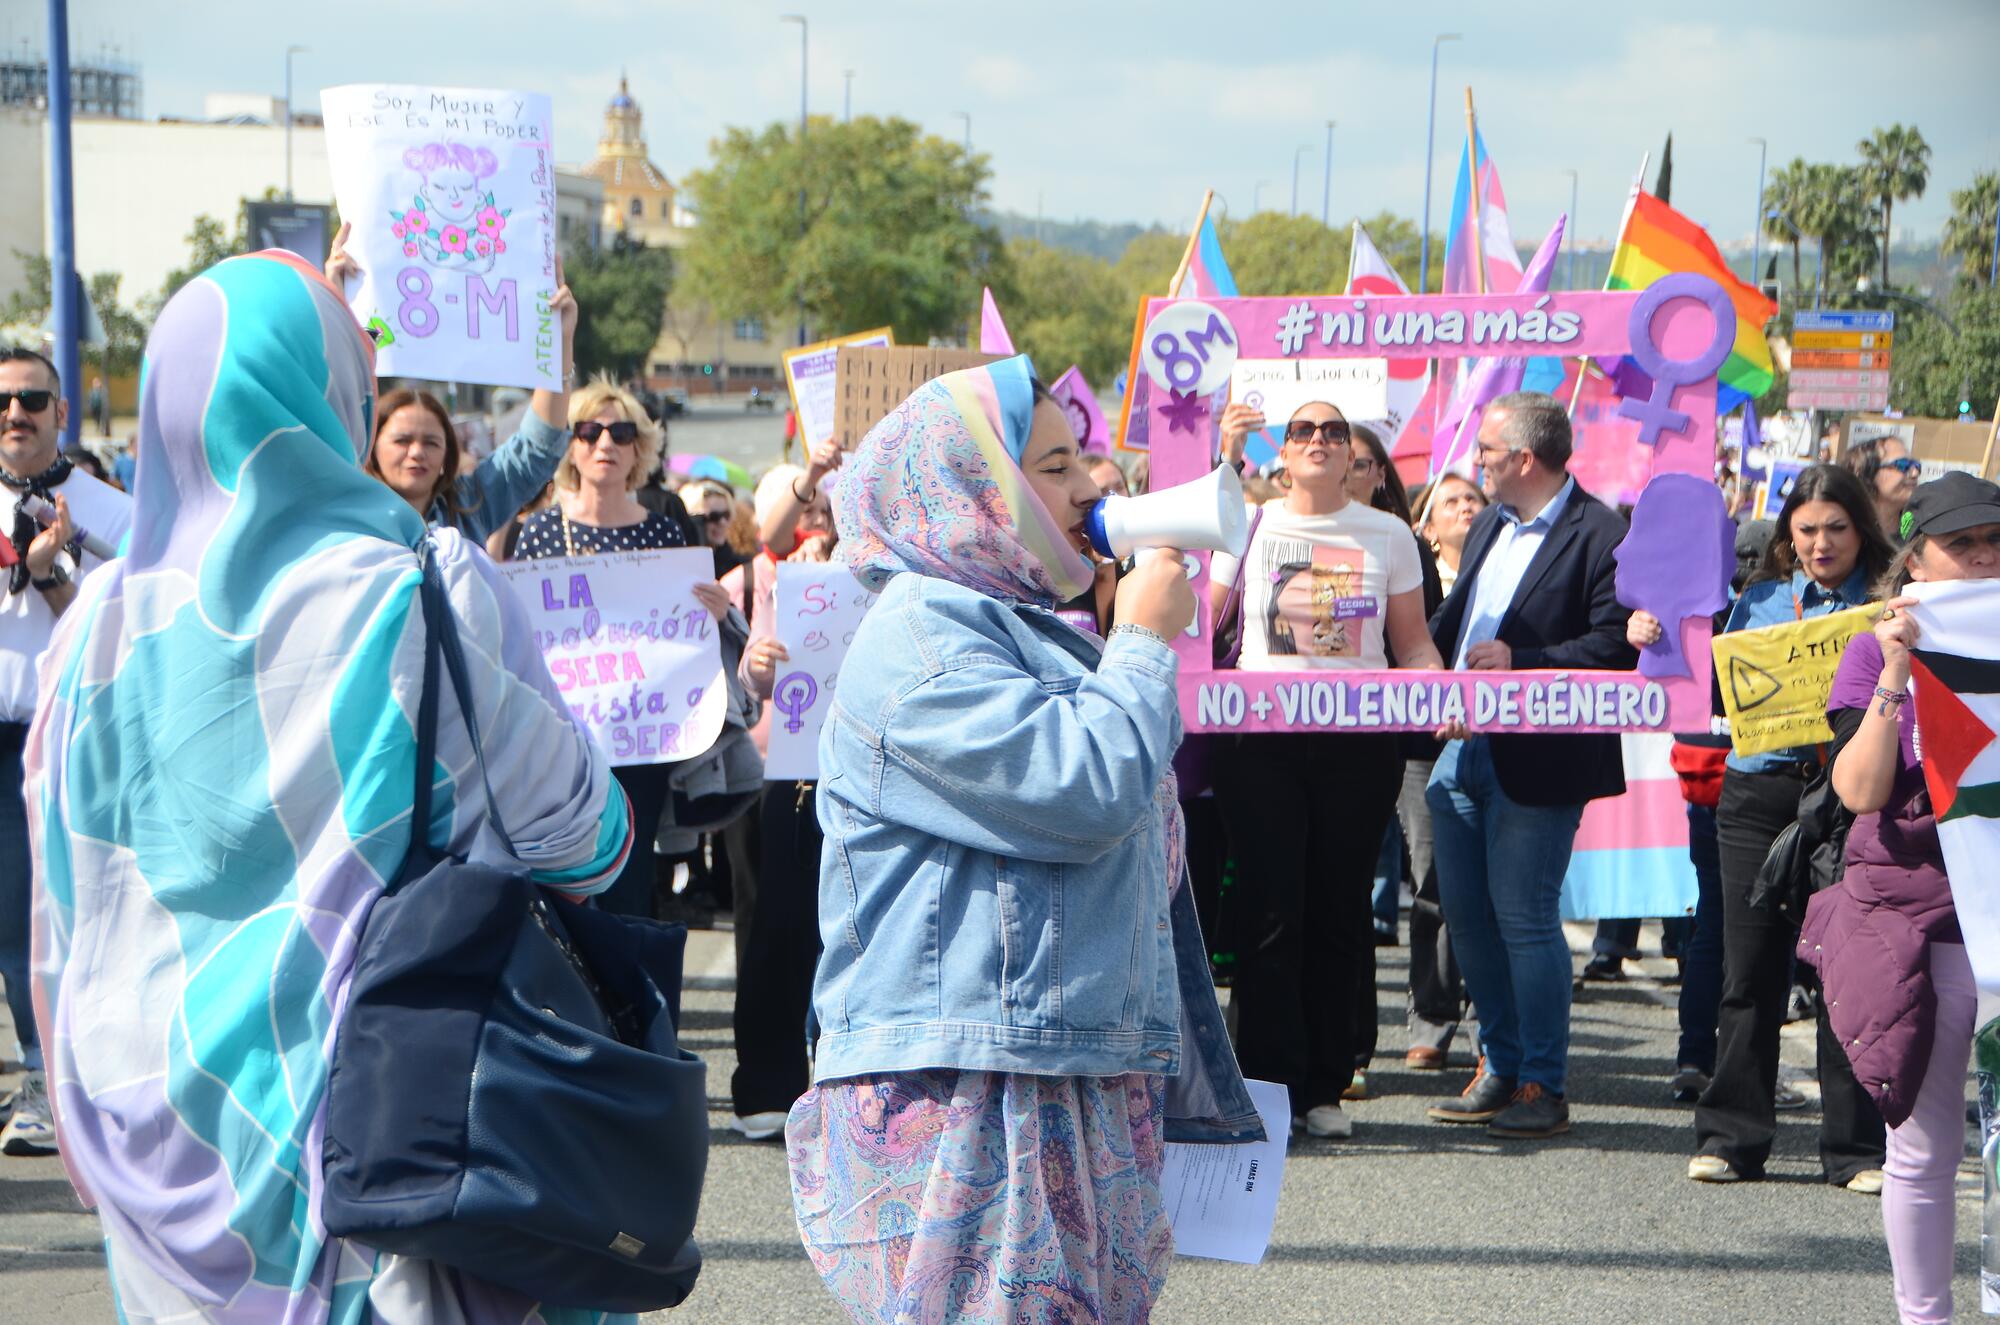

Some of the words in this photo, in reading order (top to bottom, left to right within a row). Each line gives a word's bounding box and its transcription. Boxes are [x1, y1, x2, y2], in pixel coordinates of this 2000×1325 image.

[430, 94, 495, 115] MUJER
[446, 118, 470, 132] MI
[484, 119, 541, 140] PODER
[396, 266, 520, 342] 8-M
[1472, 294, 1582, 345] más
[535, 288, 553, 377] ATENEA
[1151, 313, 1235, 388] 8M
[541, 573, 594, 611] LA
[798, 582, 838, 618] Si
[535, 604, 711, 649] volución
[1196, 682, 1246, 727] NO
[1274, 679, 1466, 728] VIOLENCIA
[1475, 681, 1522, 727] DE
[1525, 671, 1669, 728] GÉNERO
